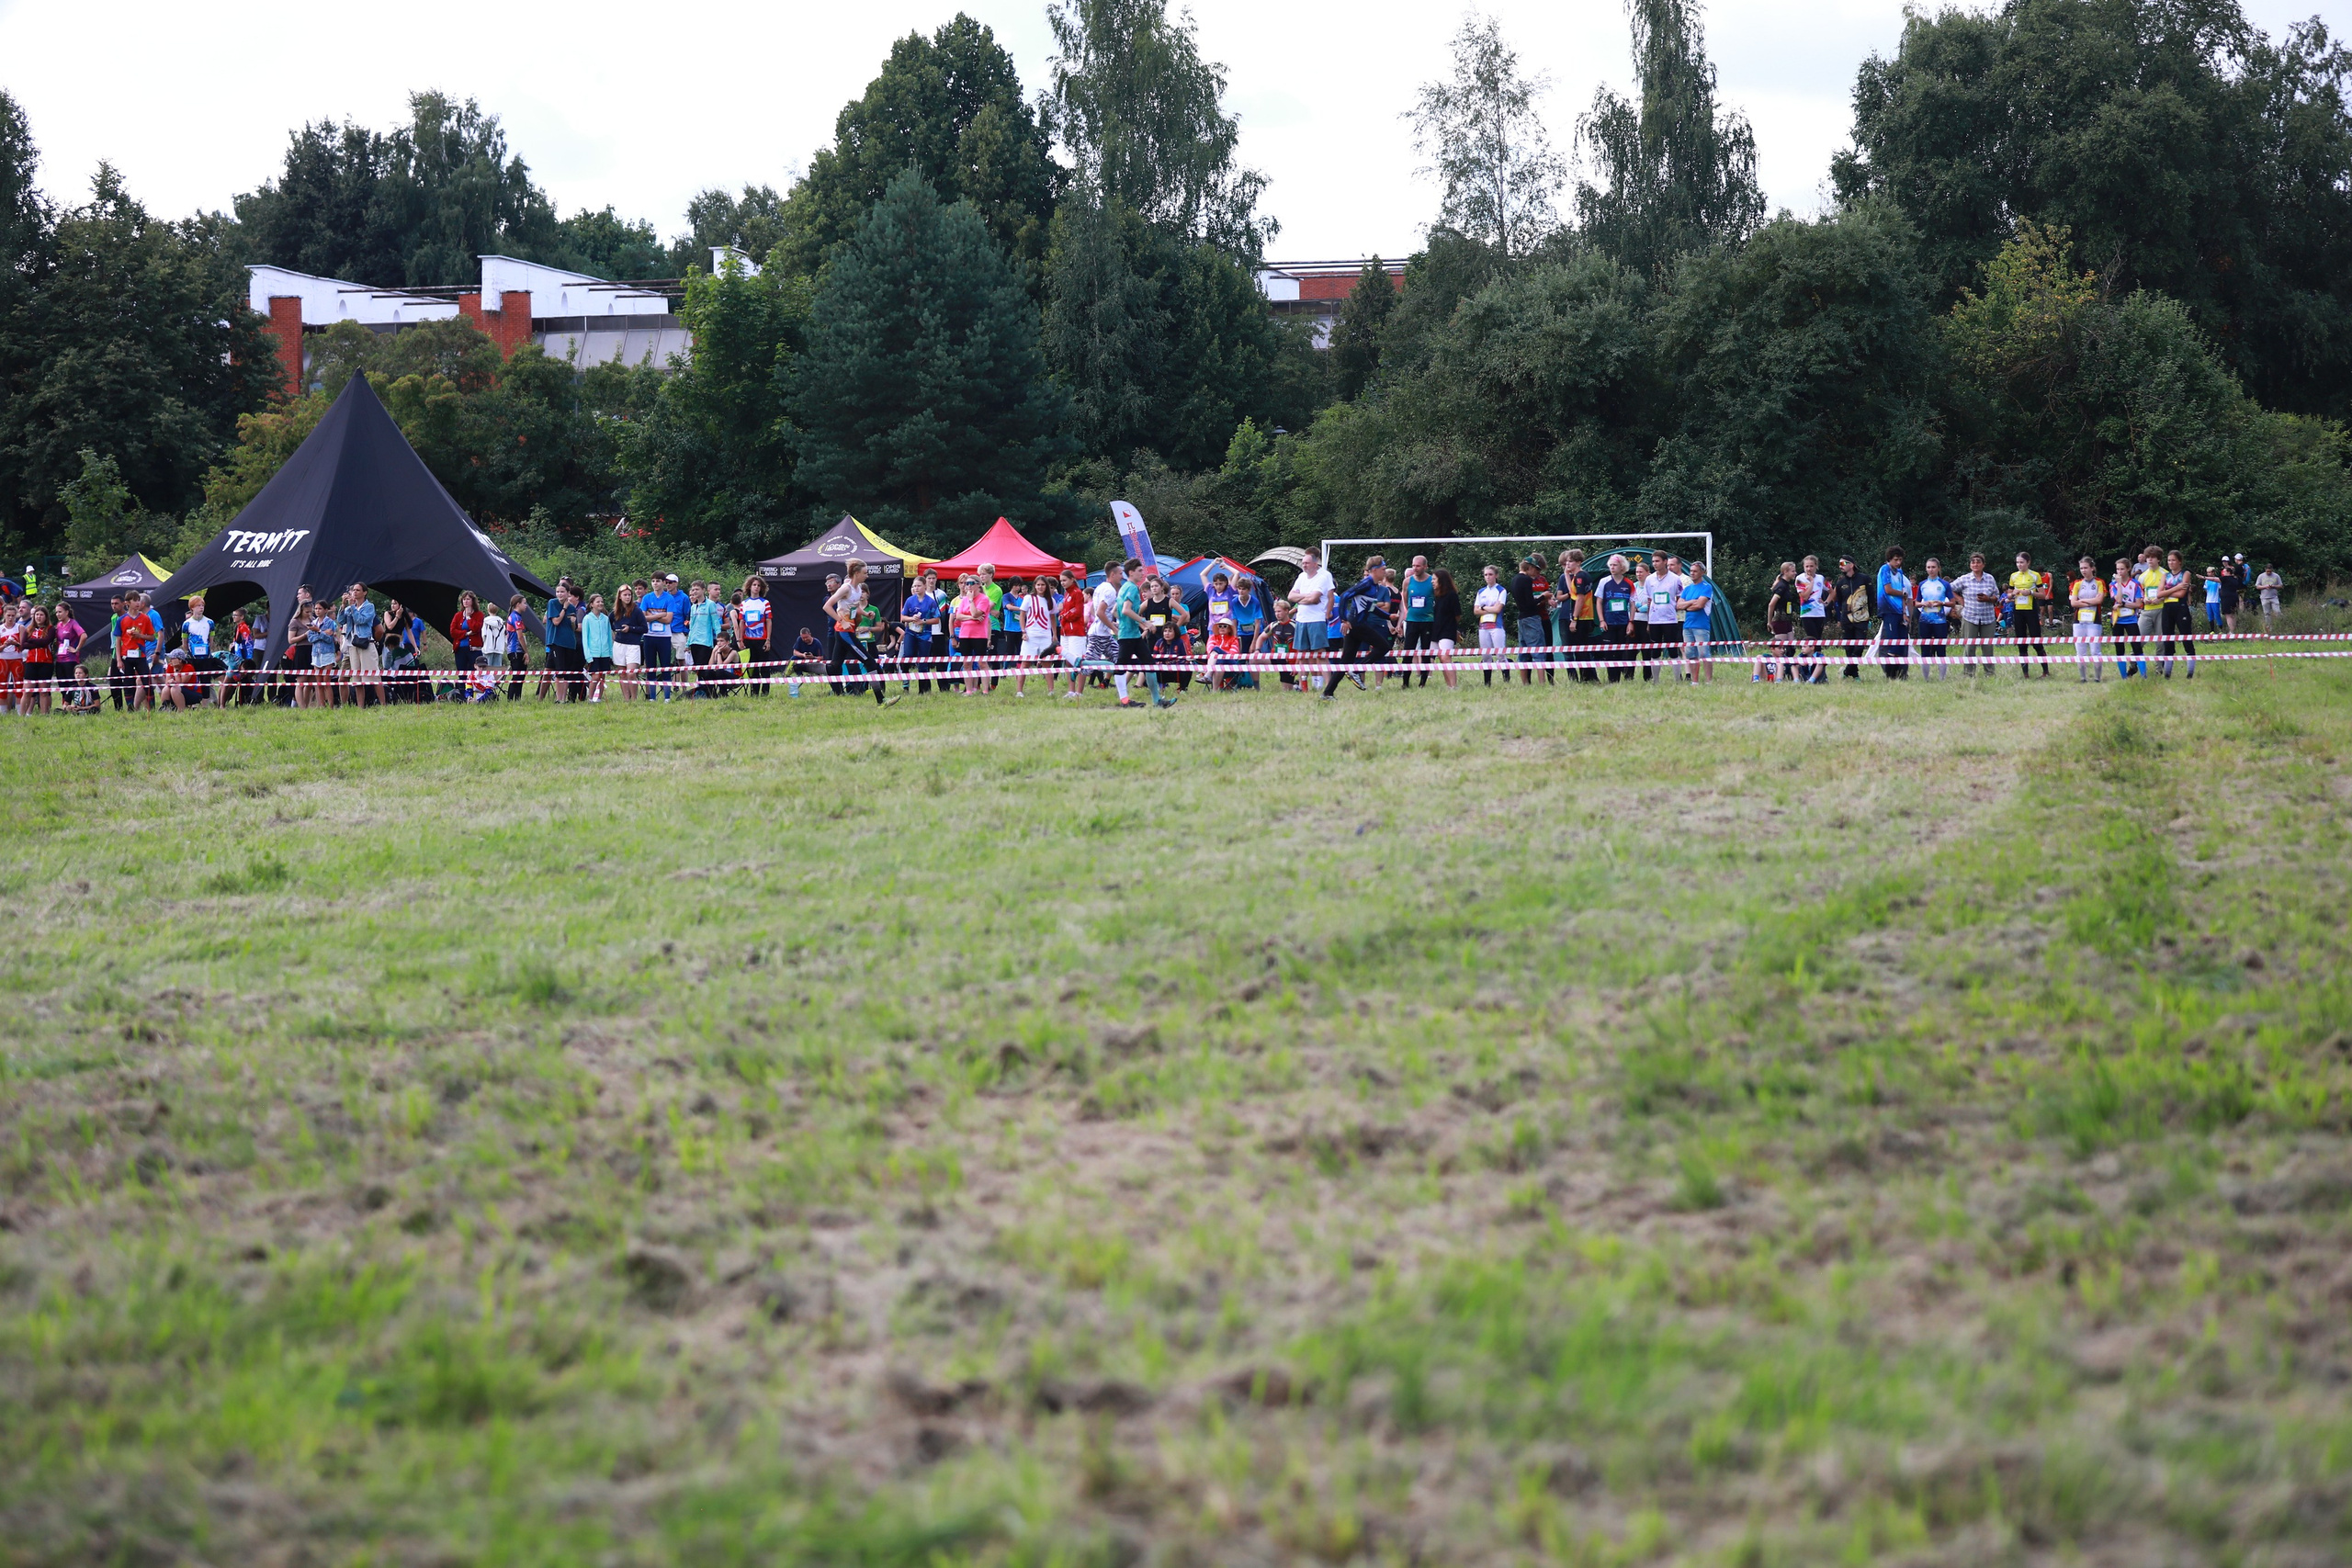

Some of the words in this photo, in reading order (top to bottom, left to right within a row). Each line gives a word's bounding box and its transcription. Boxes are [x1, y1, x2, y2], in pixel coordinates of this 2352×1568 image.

[222, 528, 311, 554] TERMIT
[230, 559, 247, 569] IT'S
[243, 559, 258, 569] ALL
